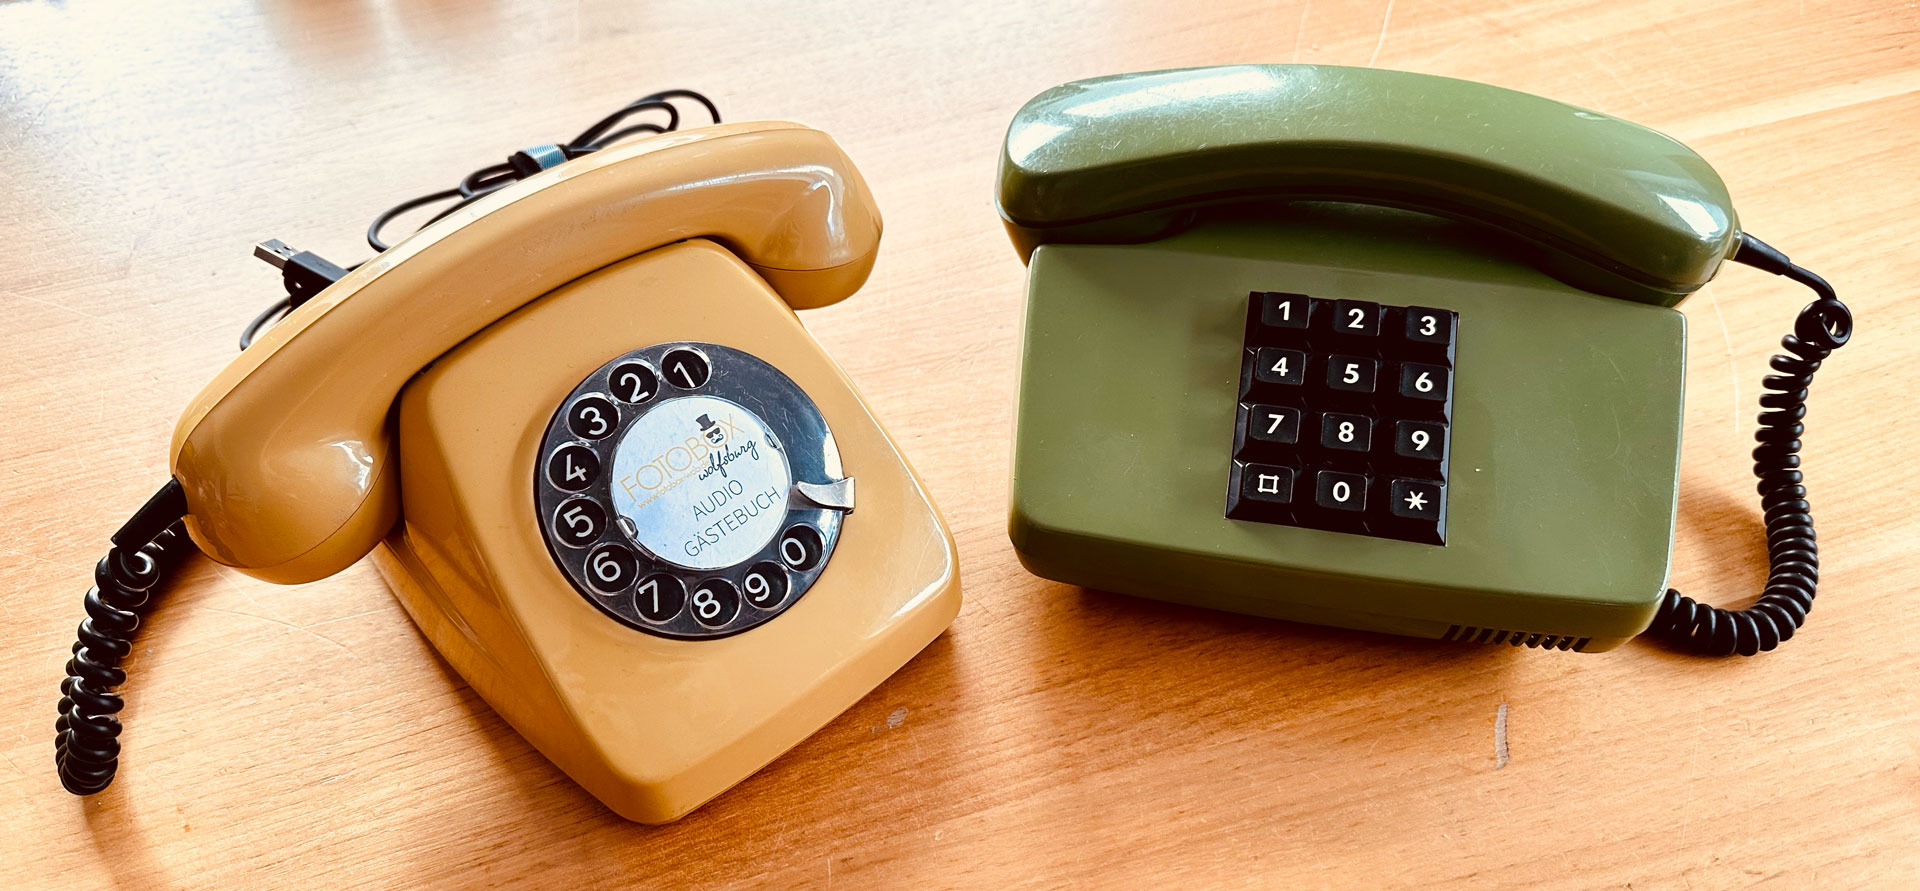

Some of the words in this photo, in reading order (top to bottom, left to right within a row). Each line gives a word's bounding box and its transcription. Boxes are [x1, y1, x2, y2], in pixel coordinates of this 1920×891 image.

[1279, 302, 1290, 320] 1
[1348, 309, 1364, 328] 2
[1420, 316, 1436, 335] 3
[620, 373, 649, 403] 2
[674, 362, 695, 387] 1
[1271, 357, 1288, 376] 4
[1344, 364, 1359, 383] 5
[1416, 372, 1433, 392] 6
[580, 407, 607, 435] 3
[1267, 414, 1284, 433] 7
[1339, 422, 1354, 442] 8
[1412, 431, 1429, 450] 9
[566, 454, 586, 481] 4
[620, 413, 744, 502] FOTOBOX
[698, 439, 760, 481] wolfsburg
[692, 479, 744, 522] AUDIO
[1333, 482, 1350, 502] 0
[564, 509, 593, 537] 5
[684, 486, 781, 557] GÄSTEBUCH
[782, 538, 806, 565] 0
[594, 552, 620, 581] 6
[638, 580, 658, 612] 7
[745, 574, 769, 601] 9
[694, 589, 720, 618] 8
